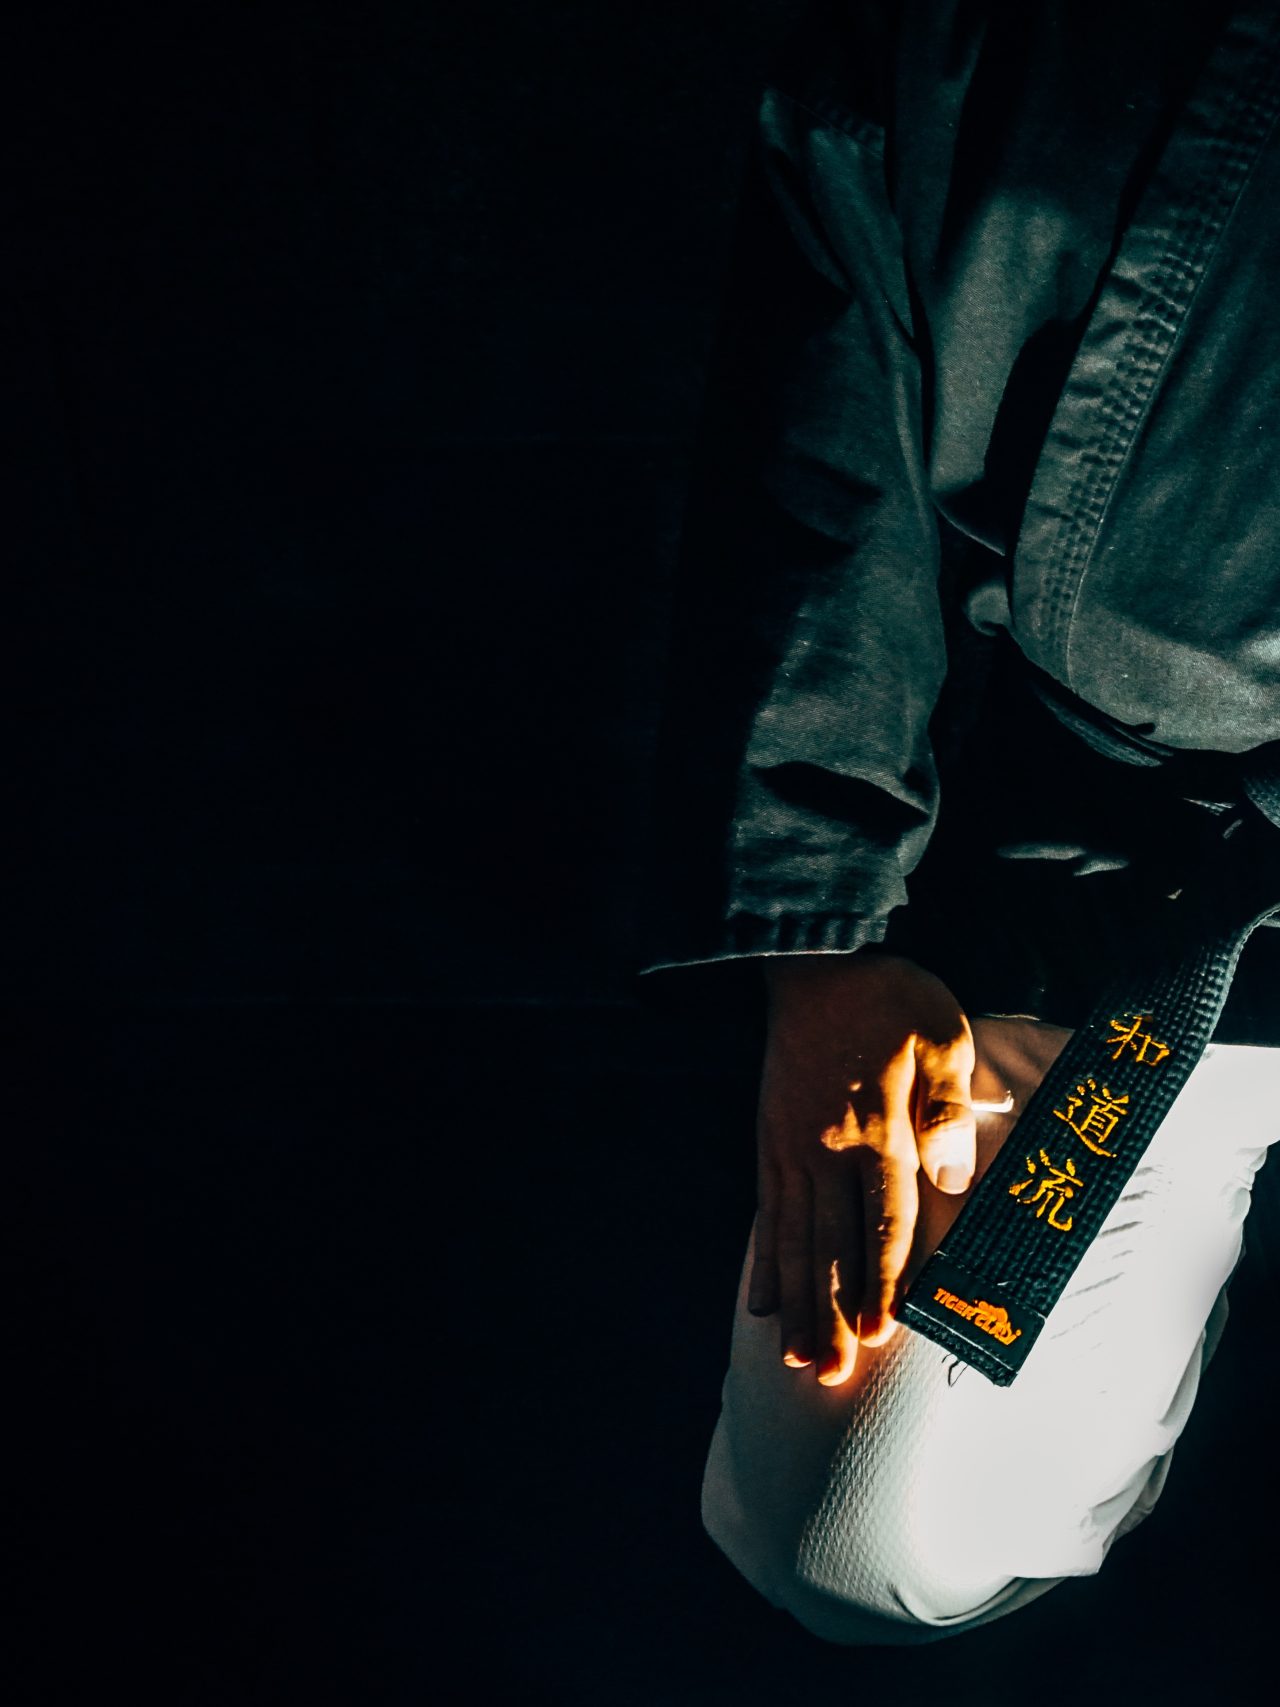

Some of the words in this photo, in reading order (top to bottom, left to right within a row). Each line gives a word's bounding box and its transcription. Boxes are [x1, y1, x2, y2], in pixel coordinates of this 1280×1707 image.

[1008, 1013, 1170, 1231] 和道流
[933, 1287, 976, 1321] TIGER
